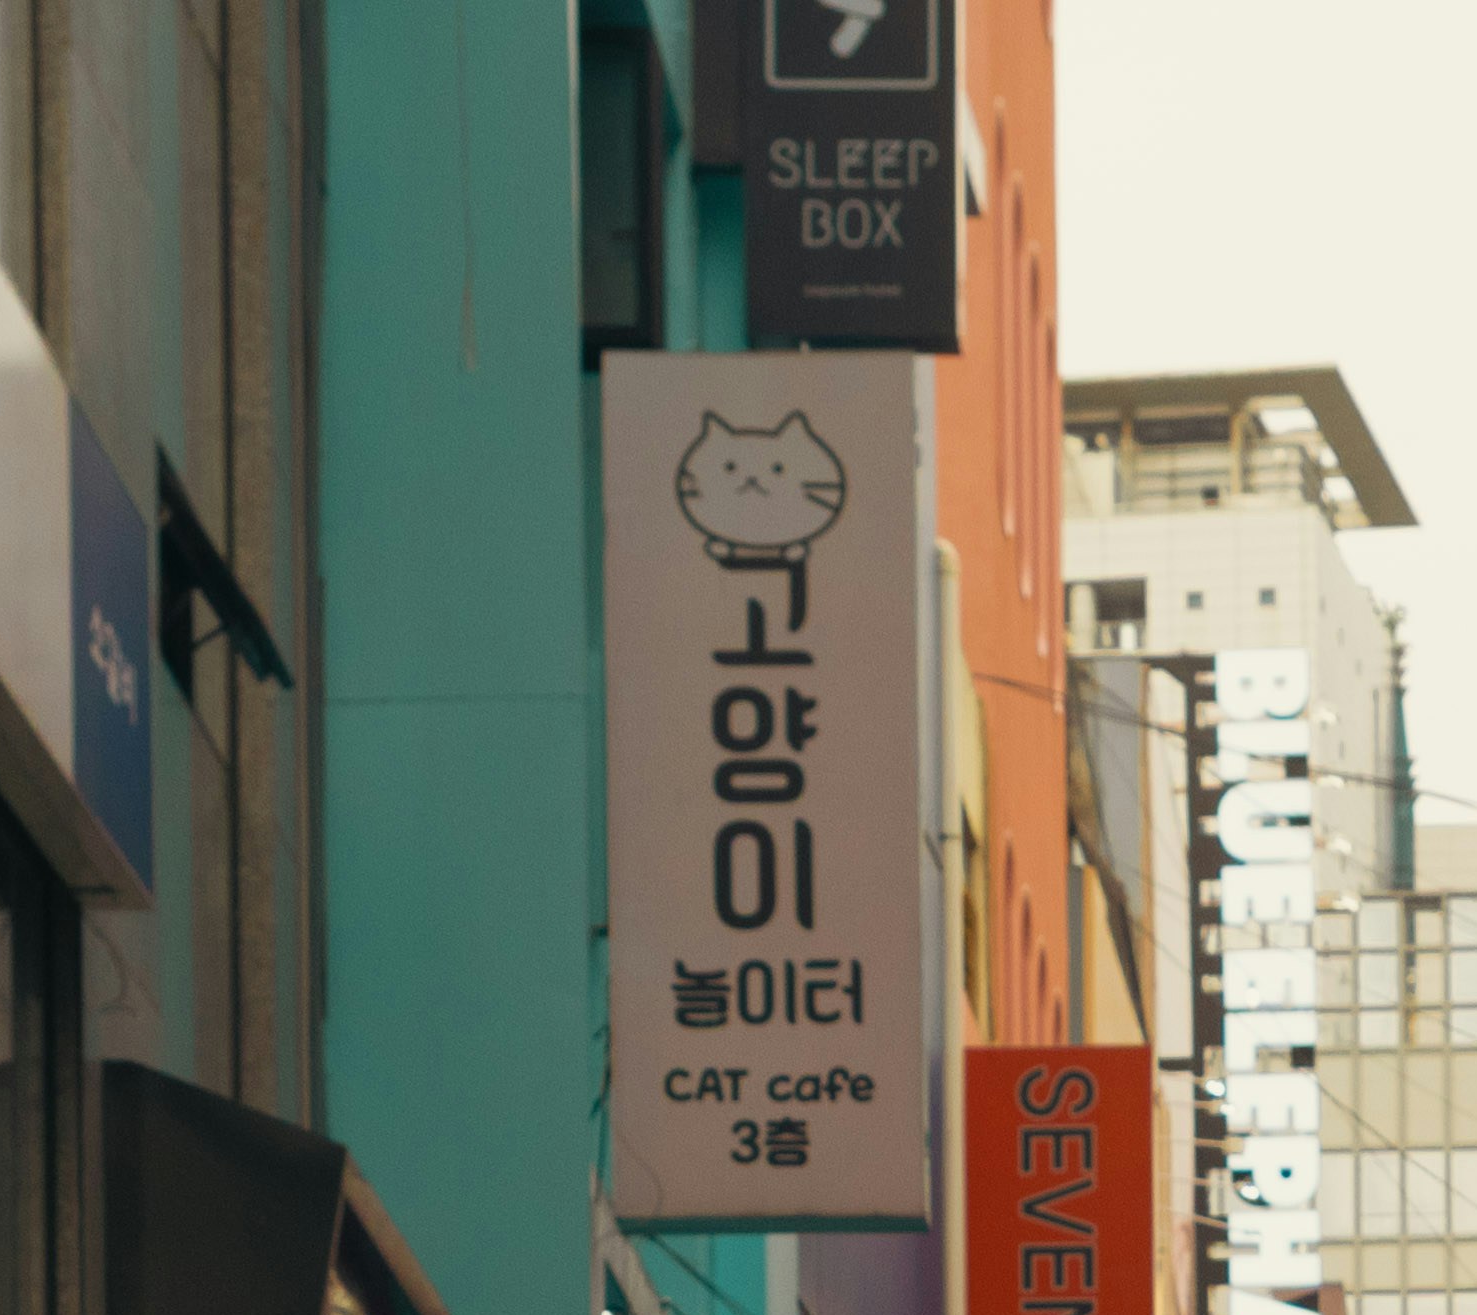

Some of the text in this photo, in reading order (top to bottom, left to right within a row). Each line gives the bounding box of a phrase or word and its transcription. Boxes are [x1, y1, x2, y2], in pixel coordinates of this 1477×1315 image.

[768, 138, 939, 189] SLEEP
[802, 198, 902, 249] BOX
[711, 557, 817, 930] 고양이
[1214, 648, 1315, 923] BLUE
[672, 958, 863, 1028] 놀이터
[663, 1067, 875, 1102] CAT cafe
[731, 1117, 809, 1167] 3층
